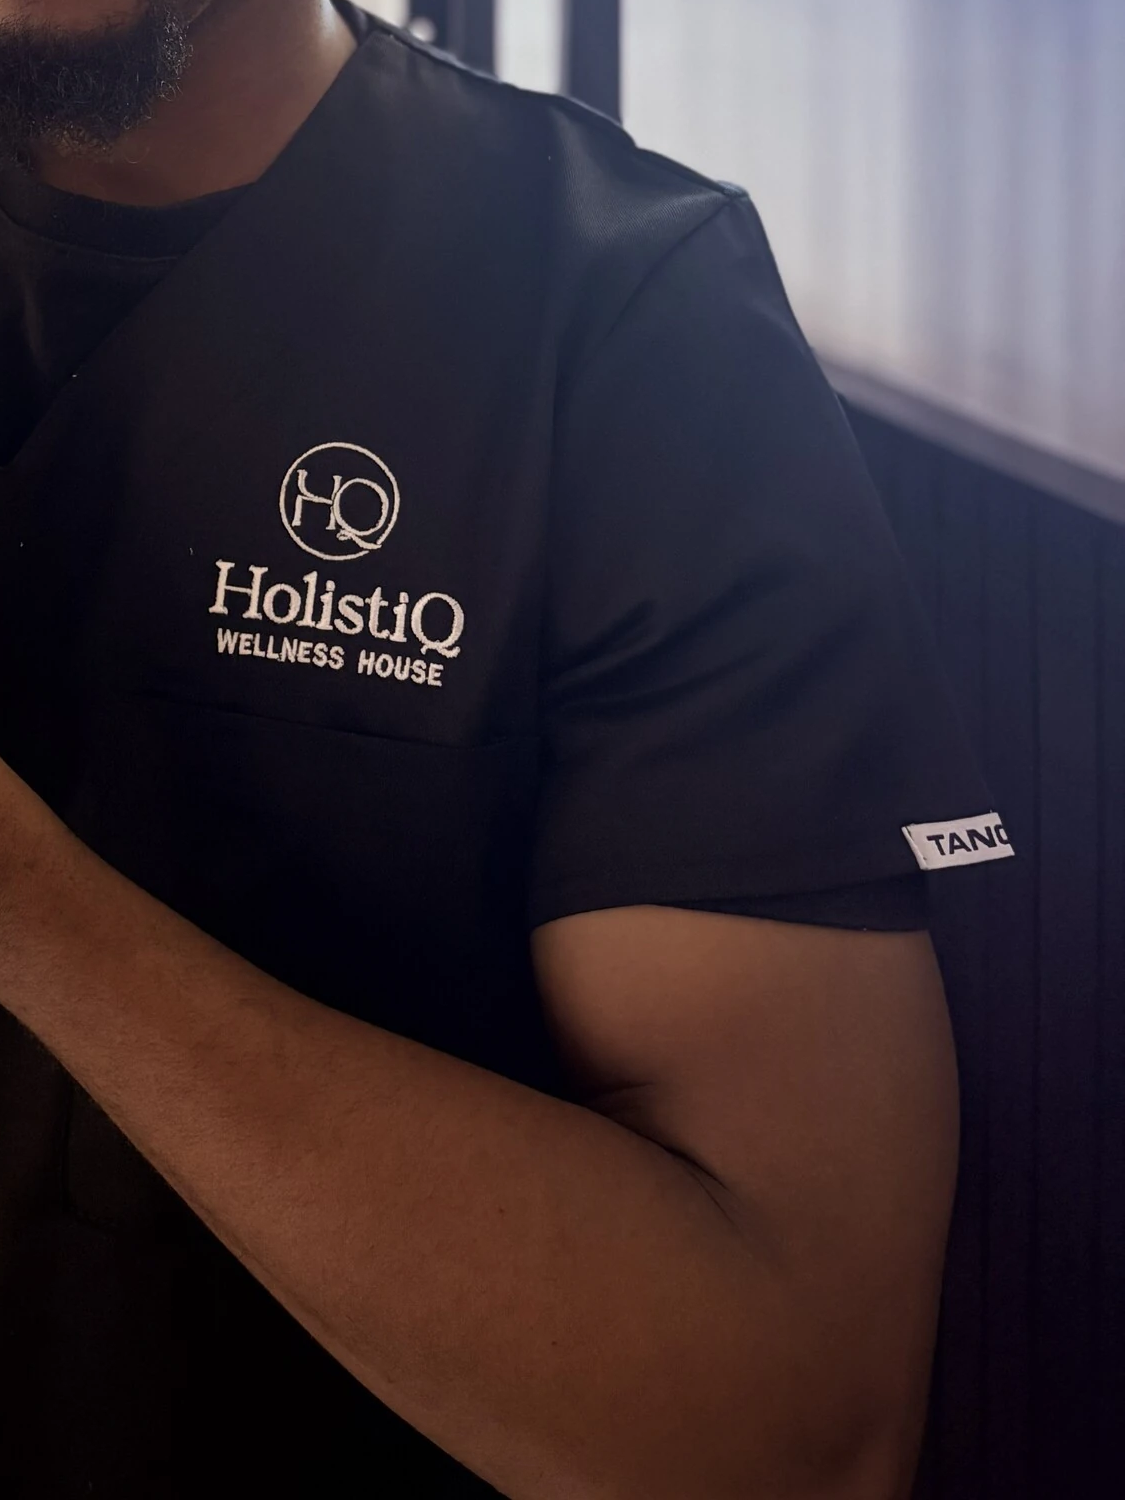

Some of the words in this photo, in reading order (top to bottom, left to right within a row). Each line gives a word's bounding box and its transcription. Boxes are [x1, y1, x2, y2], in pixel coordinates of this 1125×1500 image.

[208, 558, 465, 659] HolistiQ
[217, 627, 345, 670] WELLNESS
[358, 649, 444, 687] HOUSE
